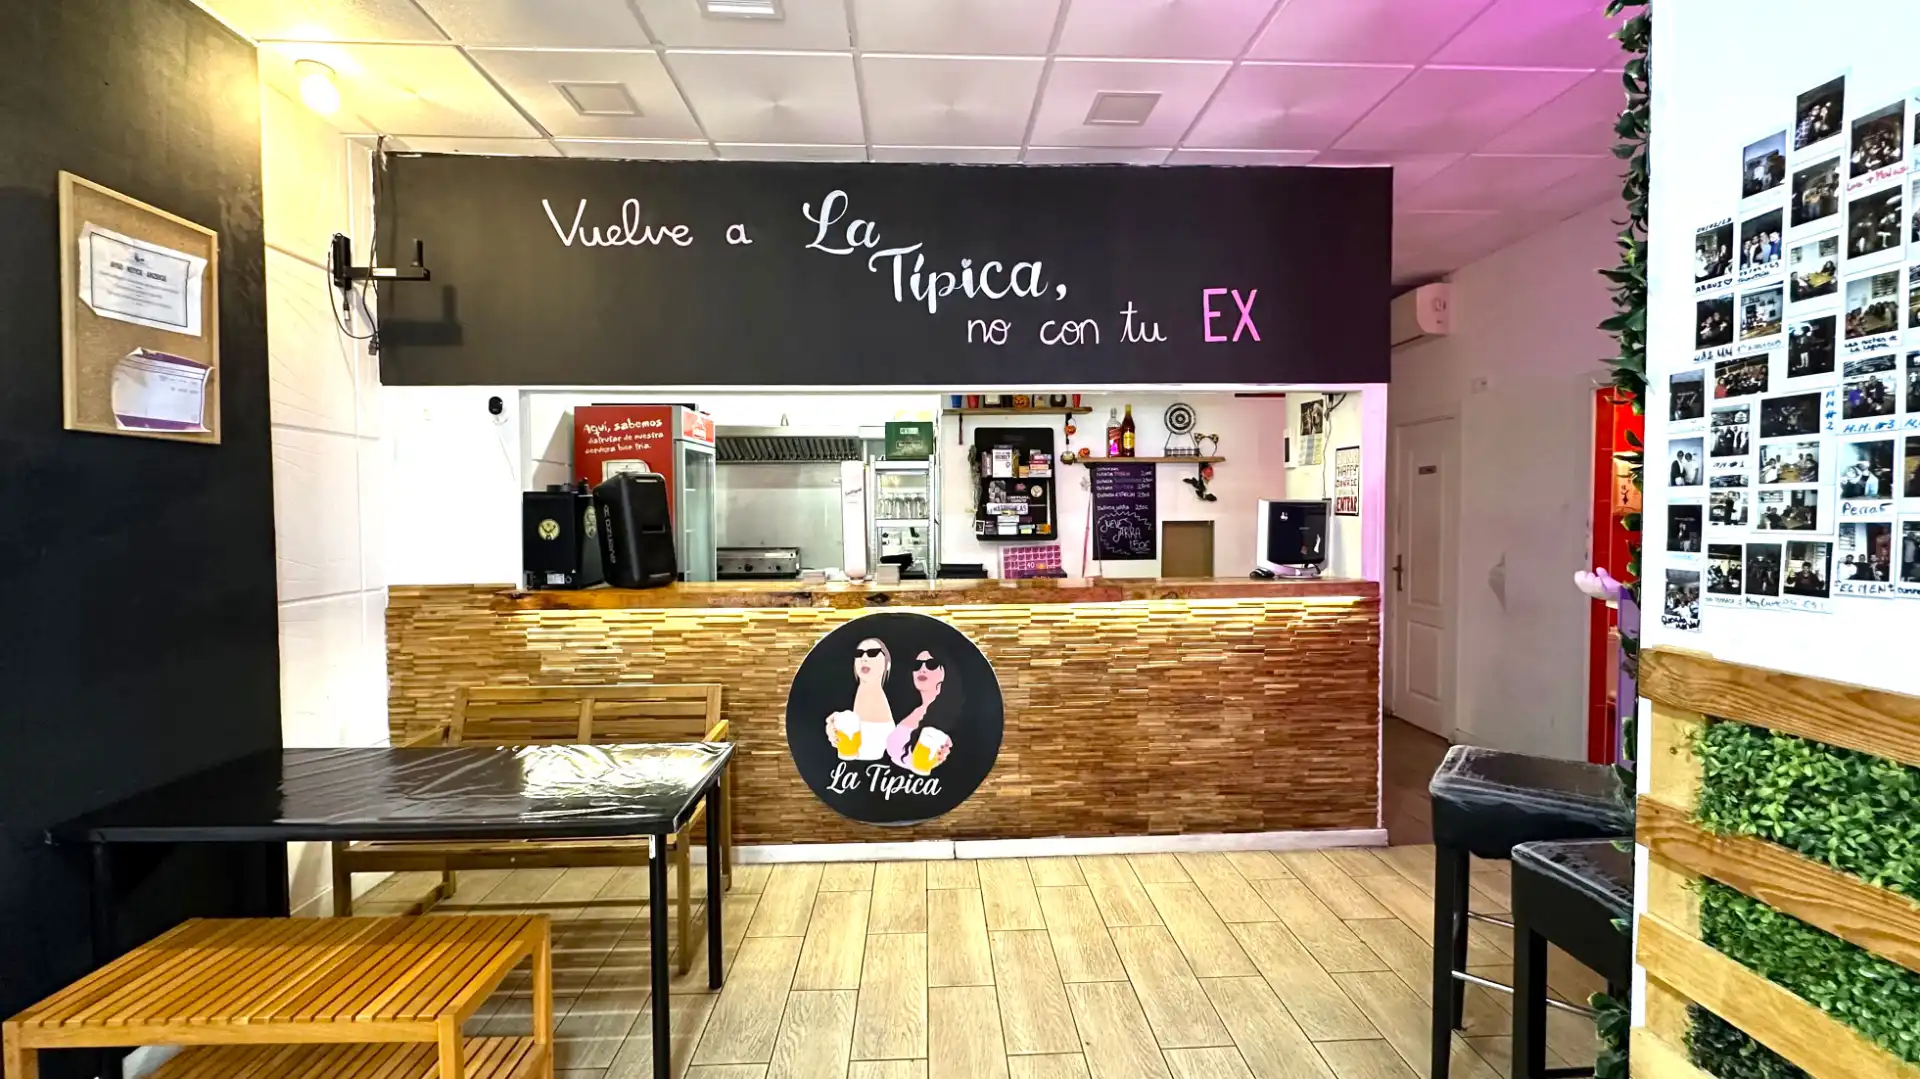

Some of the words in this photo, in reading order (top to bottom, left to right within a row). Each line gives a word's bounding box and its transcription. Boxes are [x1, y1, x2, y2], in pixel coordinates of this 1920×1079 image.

[542, 198, 693, 247] Vuelve
[725, 223, 753, 245] a
[802, 189, 880, 255] La
[868, 243, 1067, 314] Típica,
[967, 318, 1011, 346] no
[1039, 318, 1100, 346] con
[1119, 301, 1167, 343] tu
[1203, 287, 1261, 342] EX
[583, 421, 611, 437] Aquí,
[614, 418, 662, 431] sabemos
[826, 762, 861, 795] La
[865, 763, 942, 801] Típica
